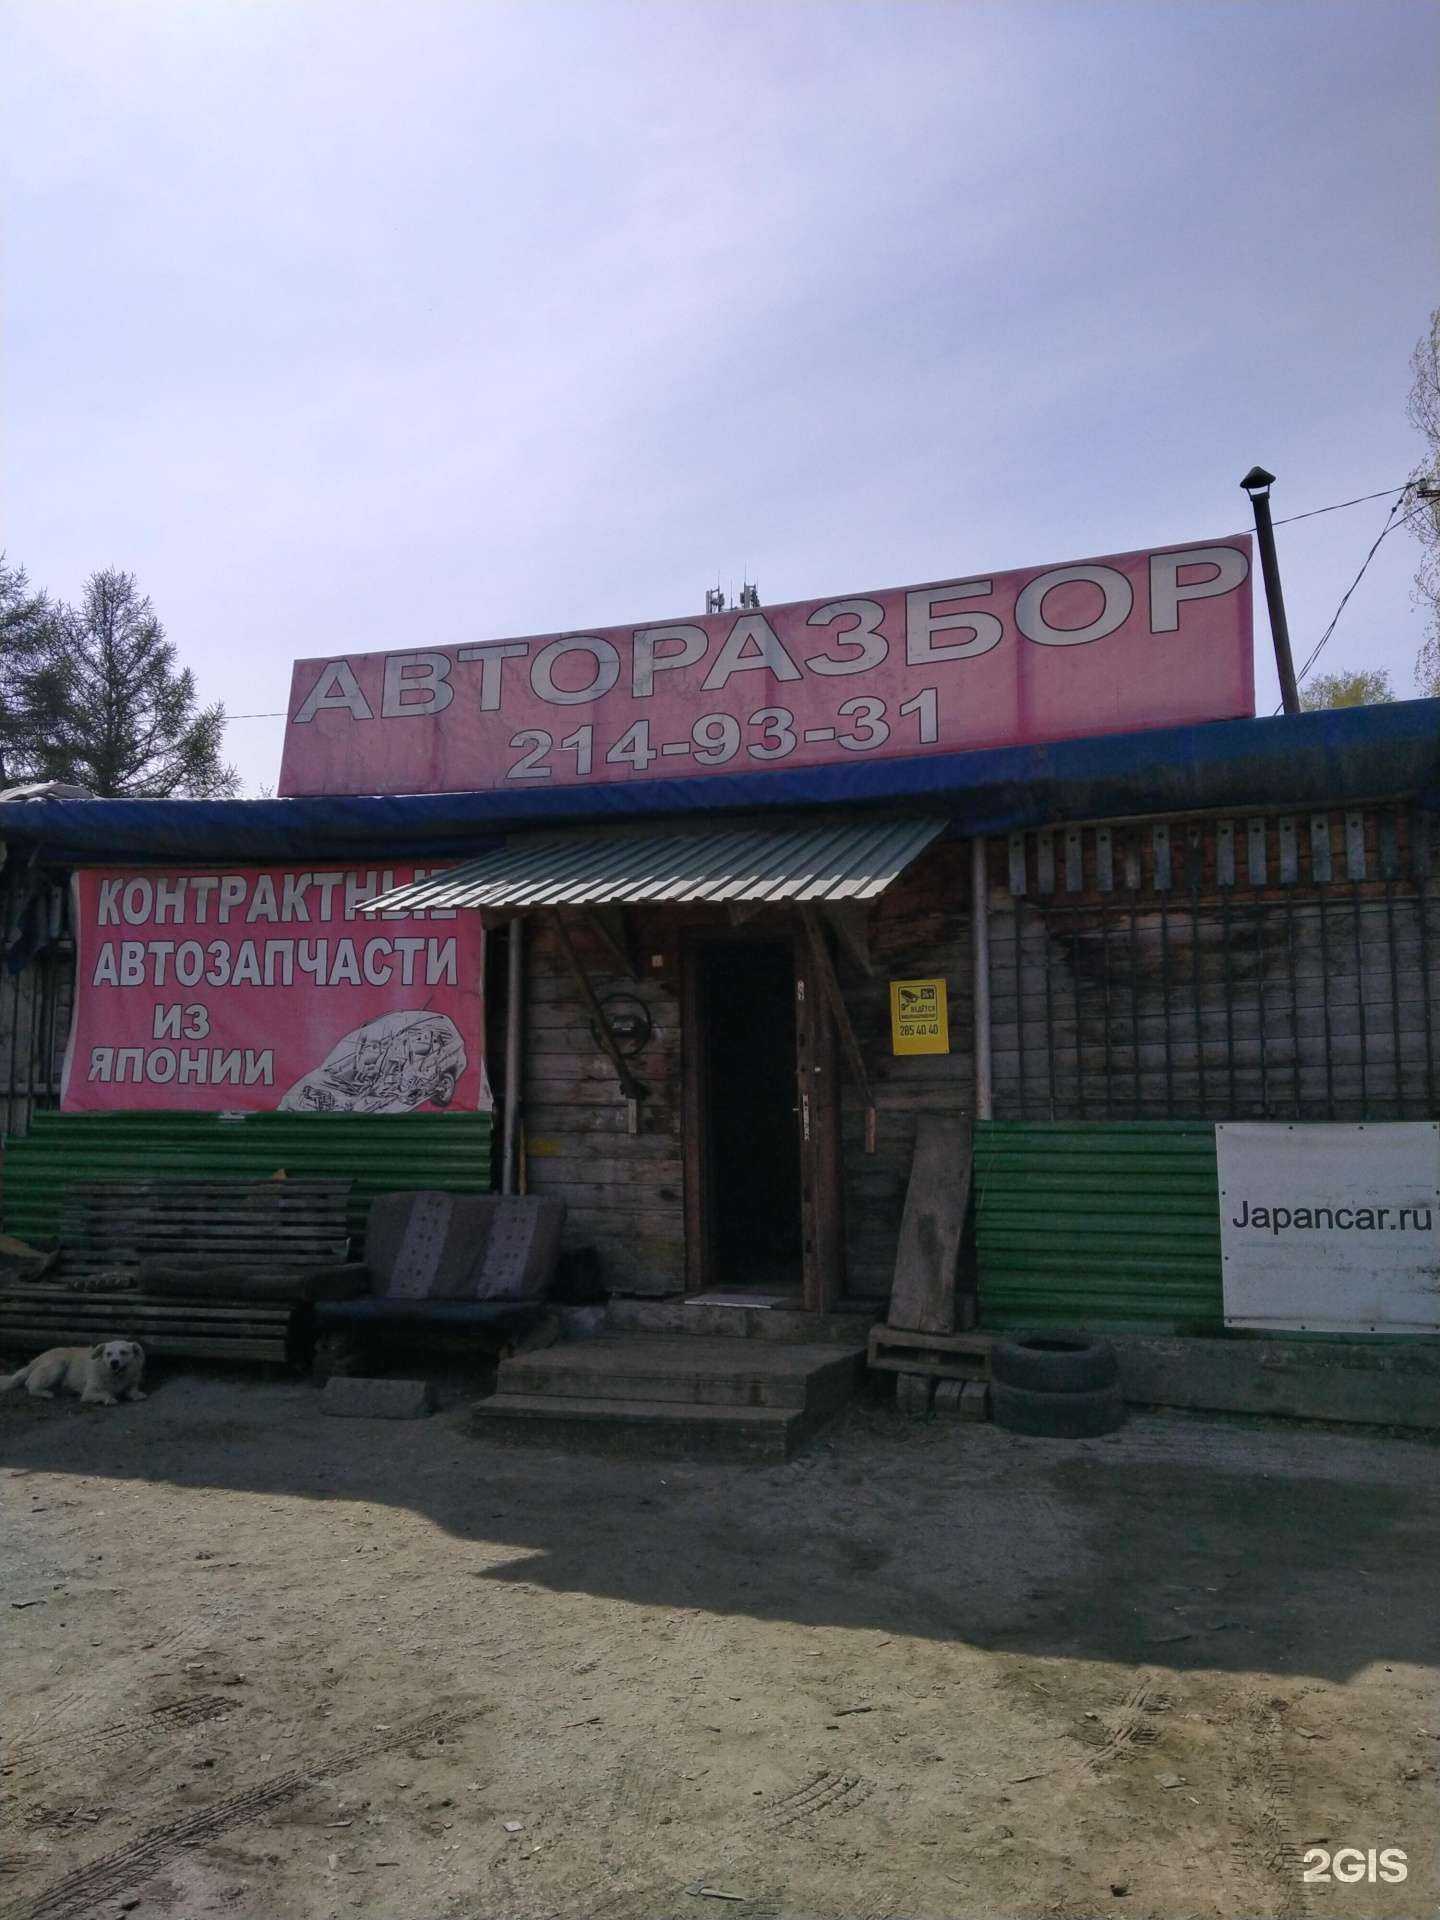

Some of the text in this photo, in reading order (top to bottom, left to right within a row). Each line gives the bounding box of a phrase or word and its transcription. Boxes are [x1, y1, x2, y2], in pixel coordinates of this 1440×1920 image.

[291, 545, 1251, 724] АВТОРАЗБОР
[505, 686, 941, 780] 214-93-31
[97, 868, 458, 926] КОНТРАКТН
[92, 936, 459, 988] АВТОЗАПЧАСТИ
[151, 1002, 212, 1041] ИЗ
[87, 1046, 275, 1086] ЯПОНИИ
[1232, 1200, 1433, 1236] Japancar.ru
